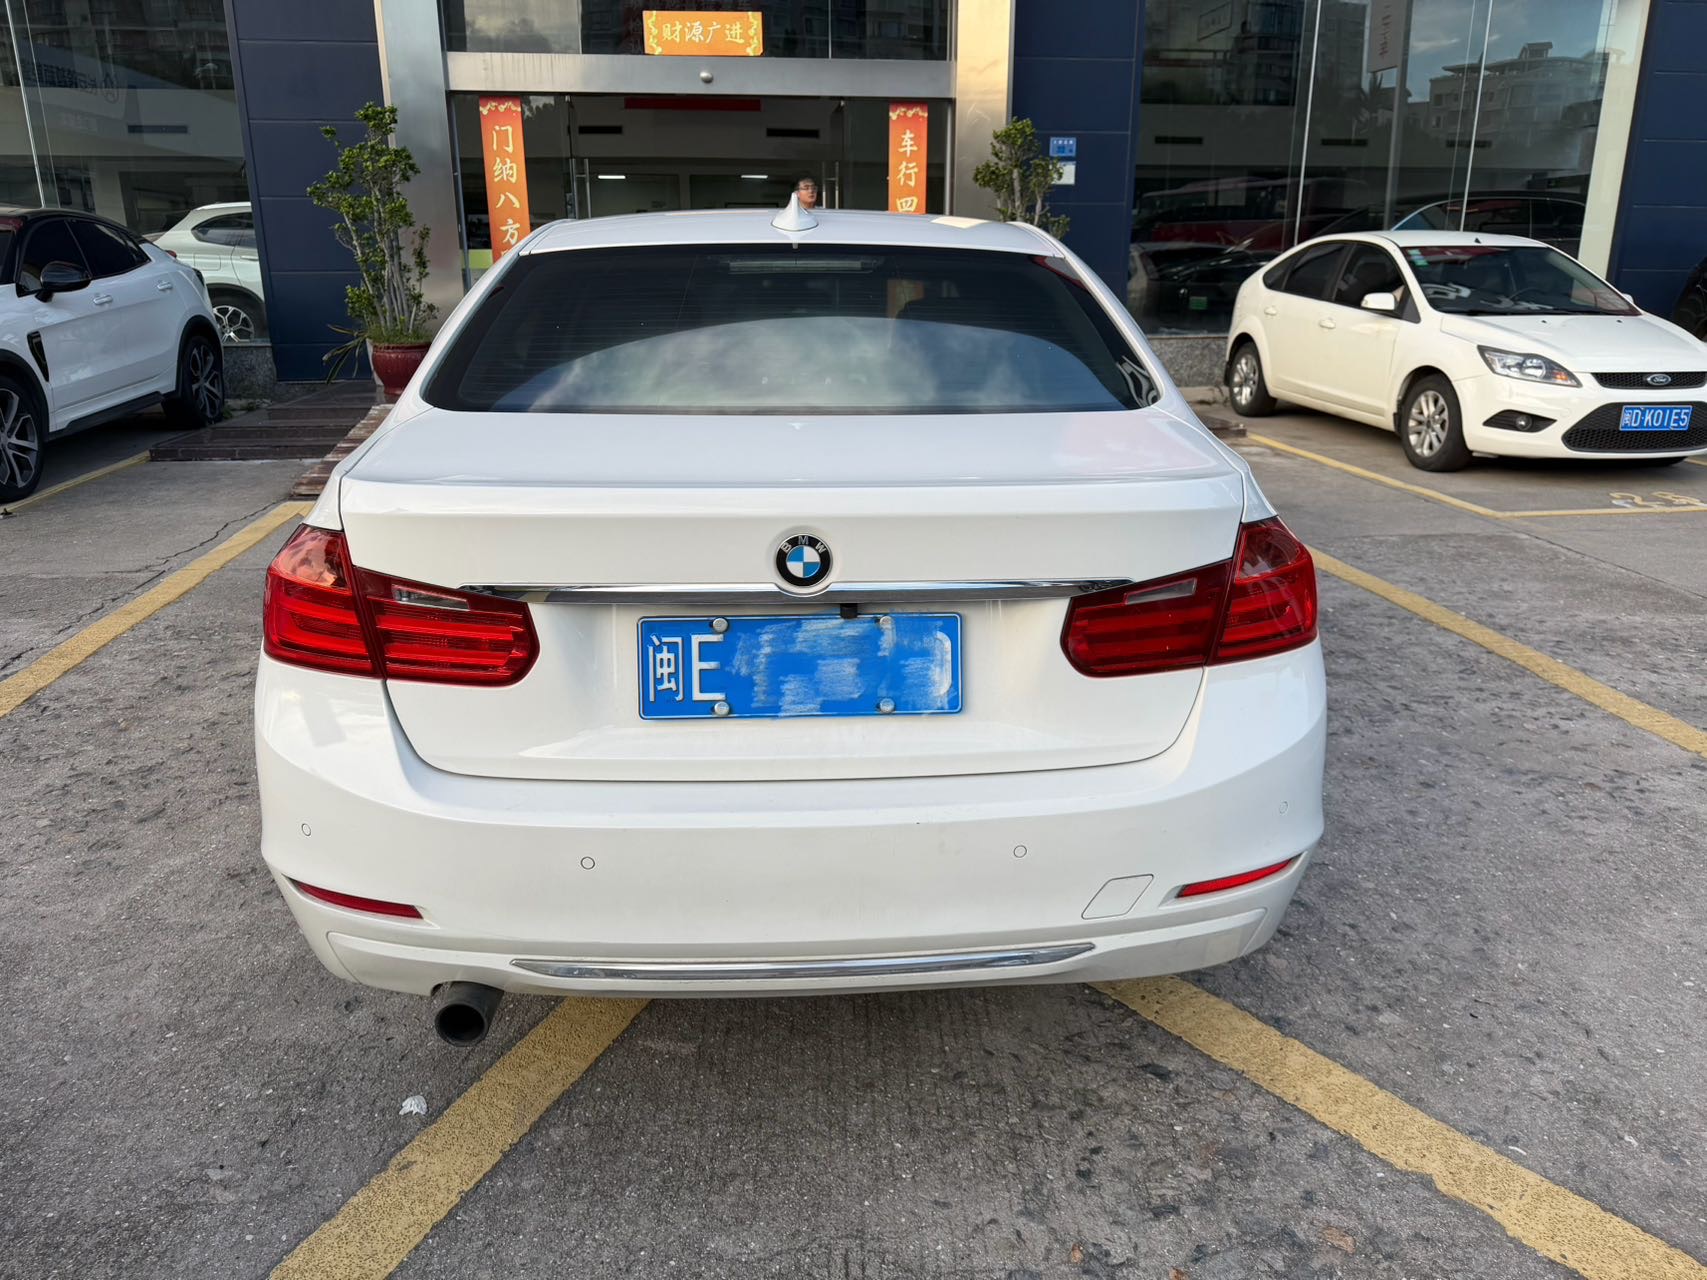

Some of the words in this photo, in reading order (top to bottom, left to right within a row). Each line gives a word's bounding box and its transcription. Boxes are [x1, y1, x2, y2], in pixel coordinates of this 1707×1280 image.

[662, 21, 745, 43] 财源广进
[492, 125, 521, 257] 门纳八方
[896, 129, 918, 212] 车行四
[780, 536, 826, 553] BMW
